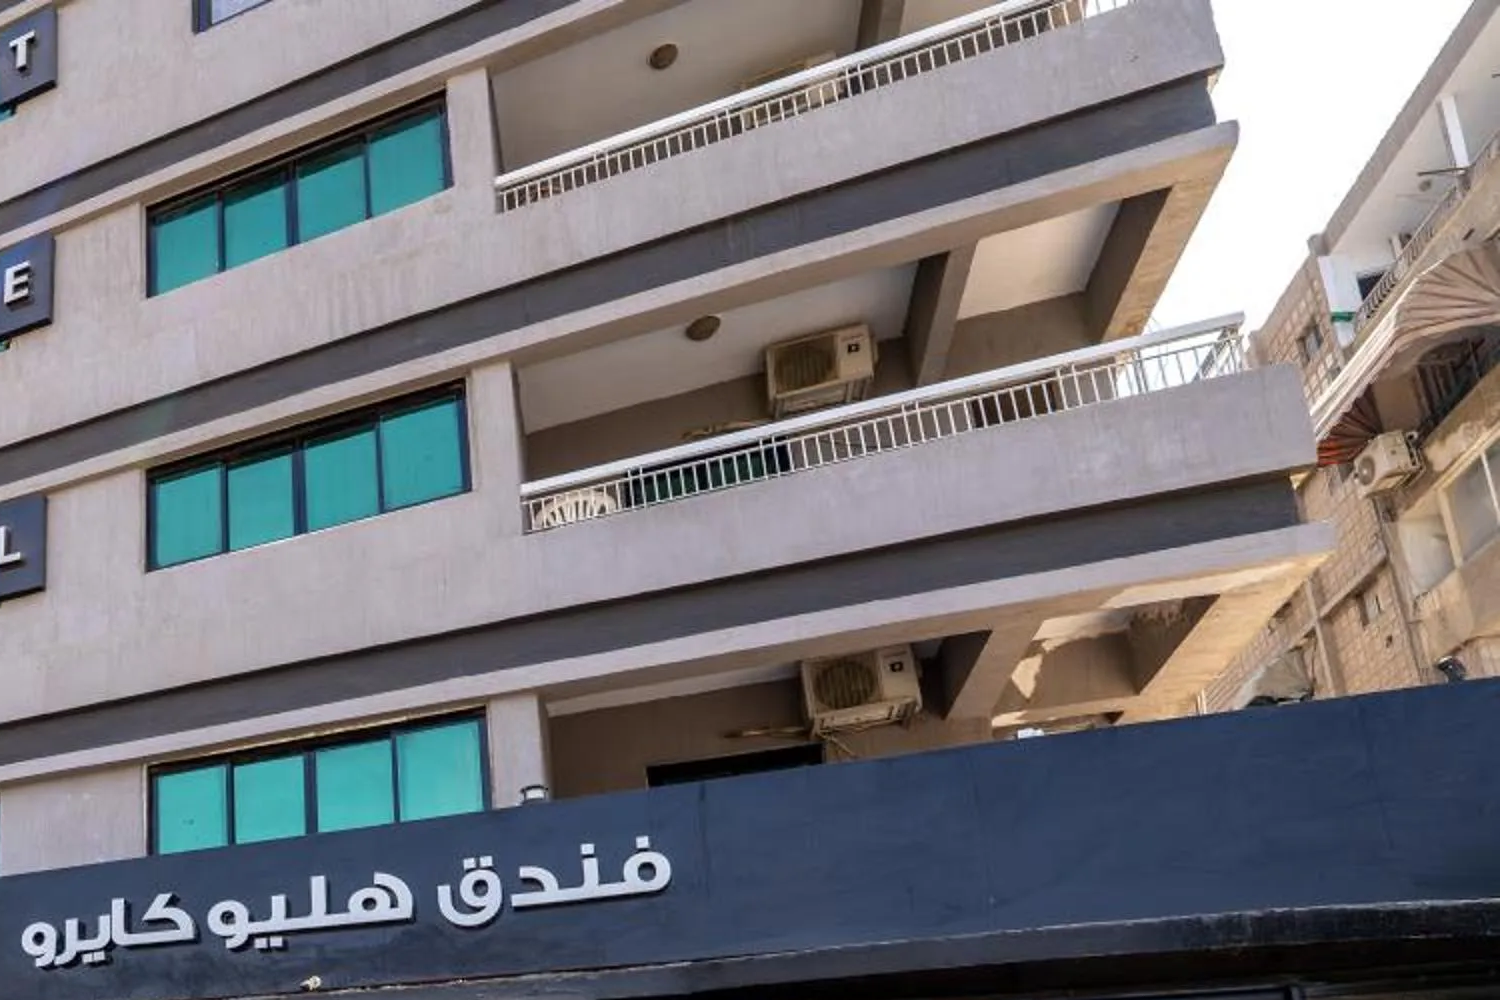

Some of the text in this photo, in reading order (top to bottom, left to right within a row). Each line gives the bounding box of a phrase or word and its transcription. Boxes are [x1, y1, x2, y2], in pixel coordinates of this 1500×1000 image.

[8, 30, 36, 70] T
[4, 260, 31, 305] E
[20, 836, 672, 967] فندق هليو كايرو
